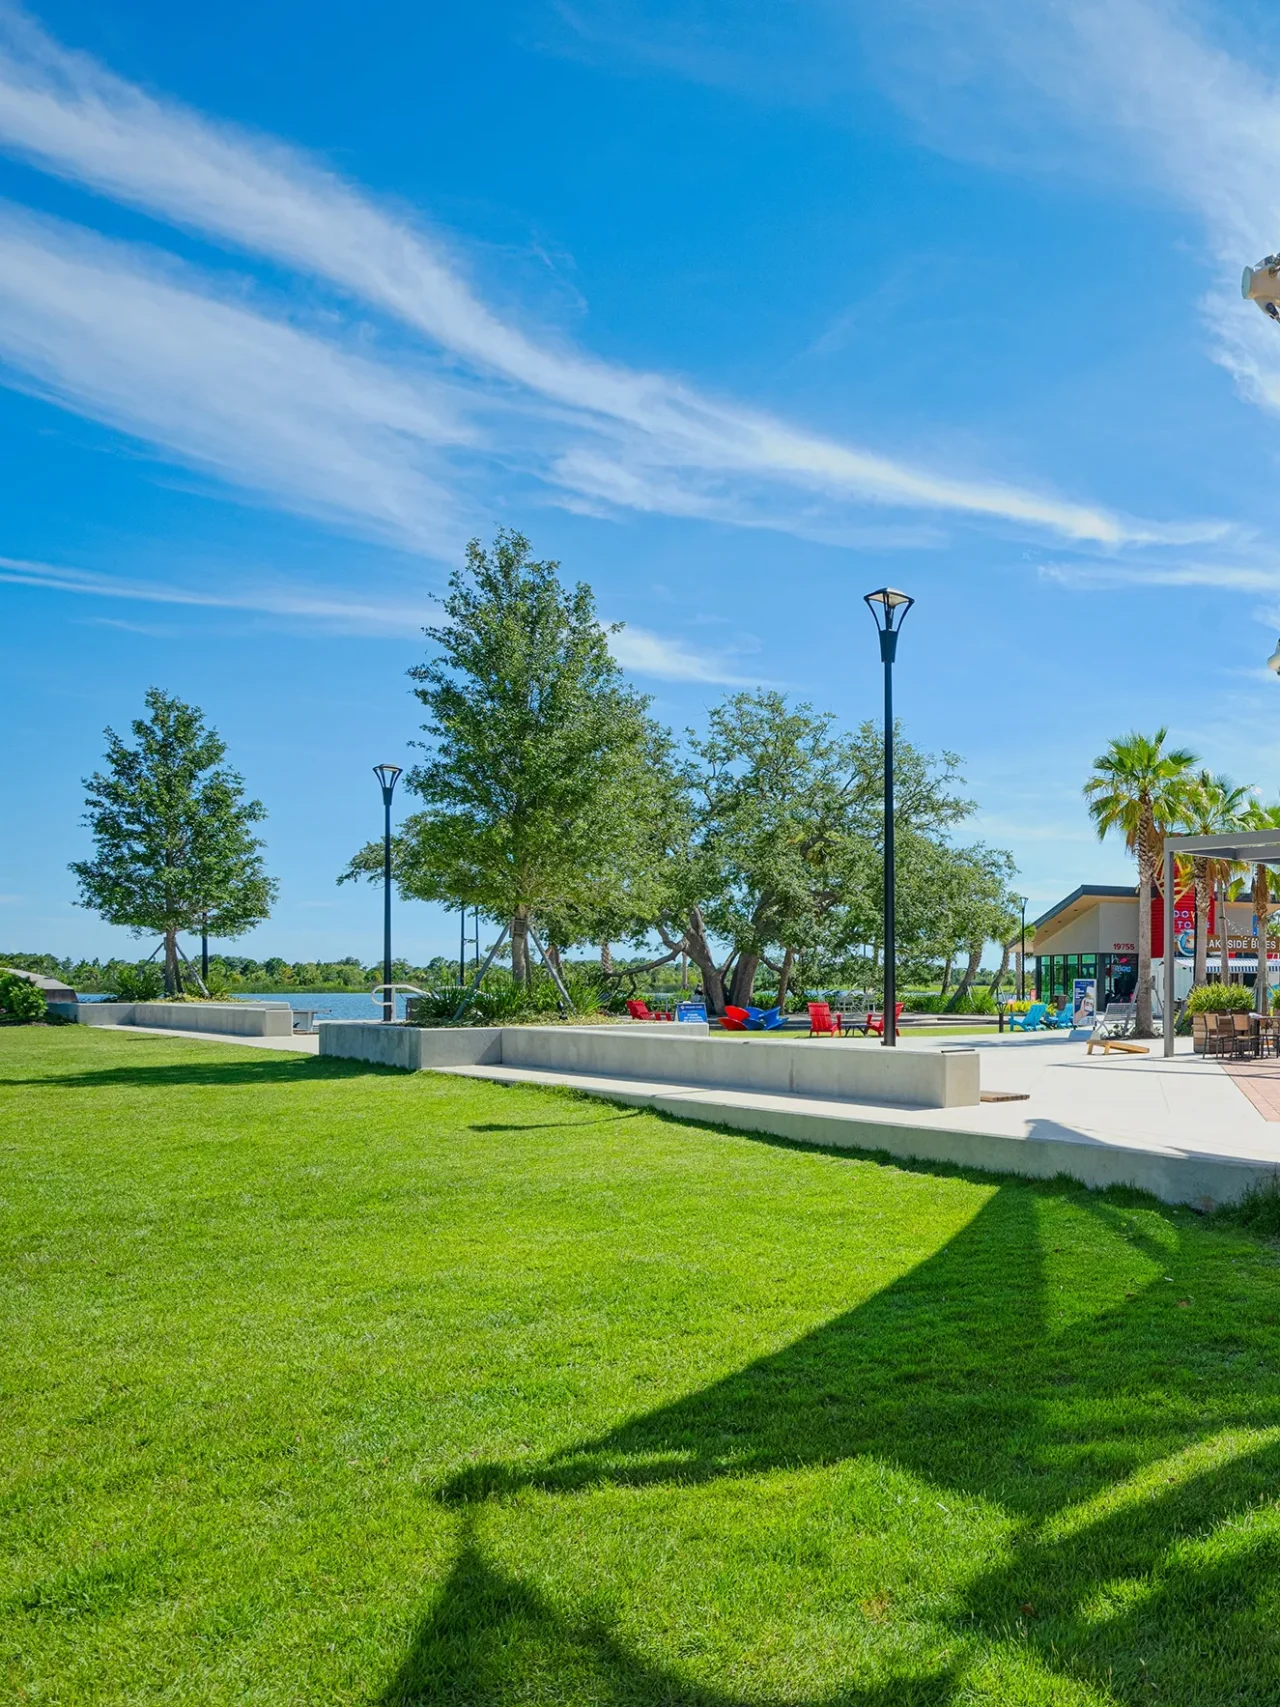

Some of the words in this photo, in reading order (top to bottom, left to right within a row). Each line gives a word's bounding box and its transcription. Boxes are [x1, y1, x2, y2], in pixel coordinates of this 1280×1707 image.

[1113, 943, 1135, 951] 19755
[1205, 939, 1248, 949] AKSIDE
[1251, 940, 1277, 950] BIES
